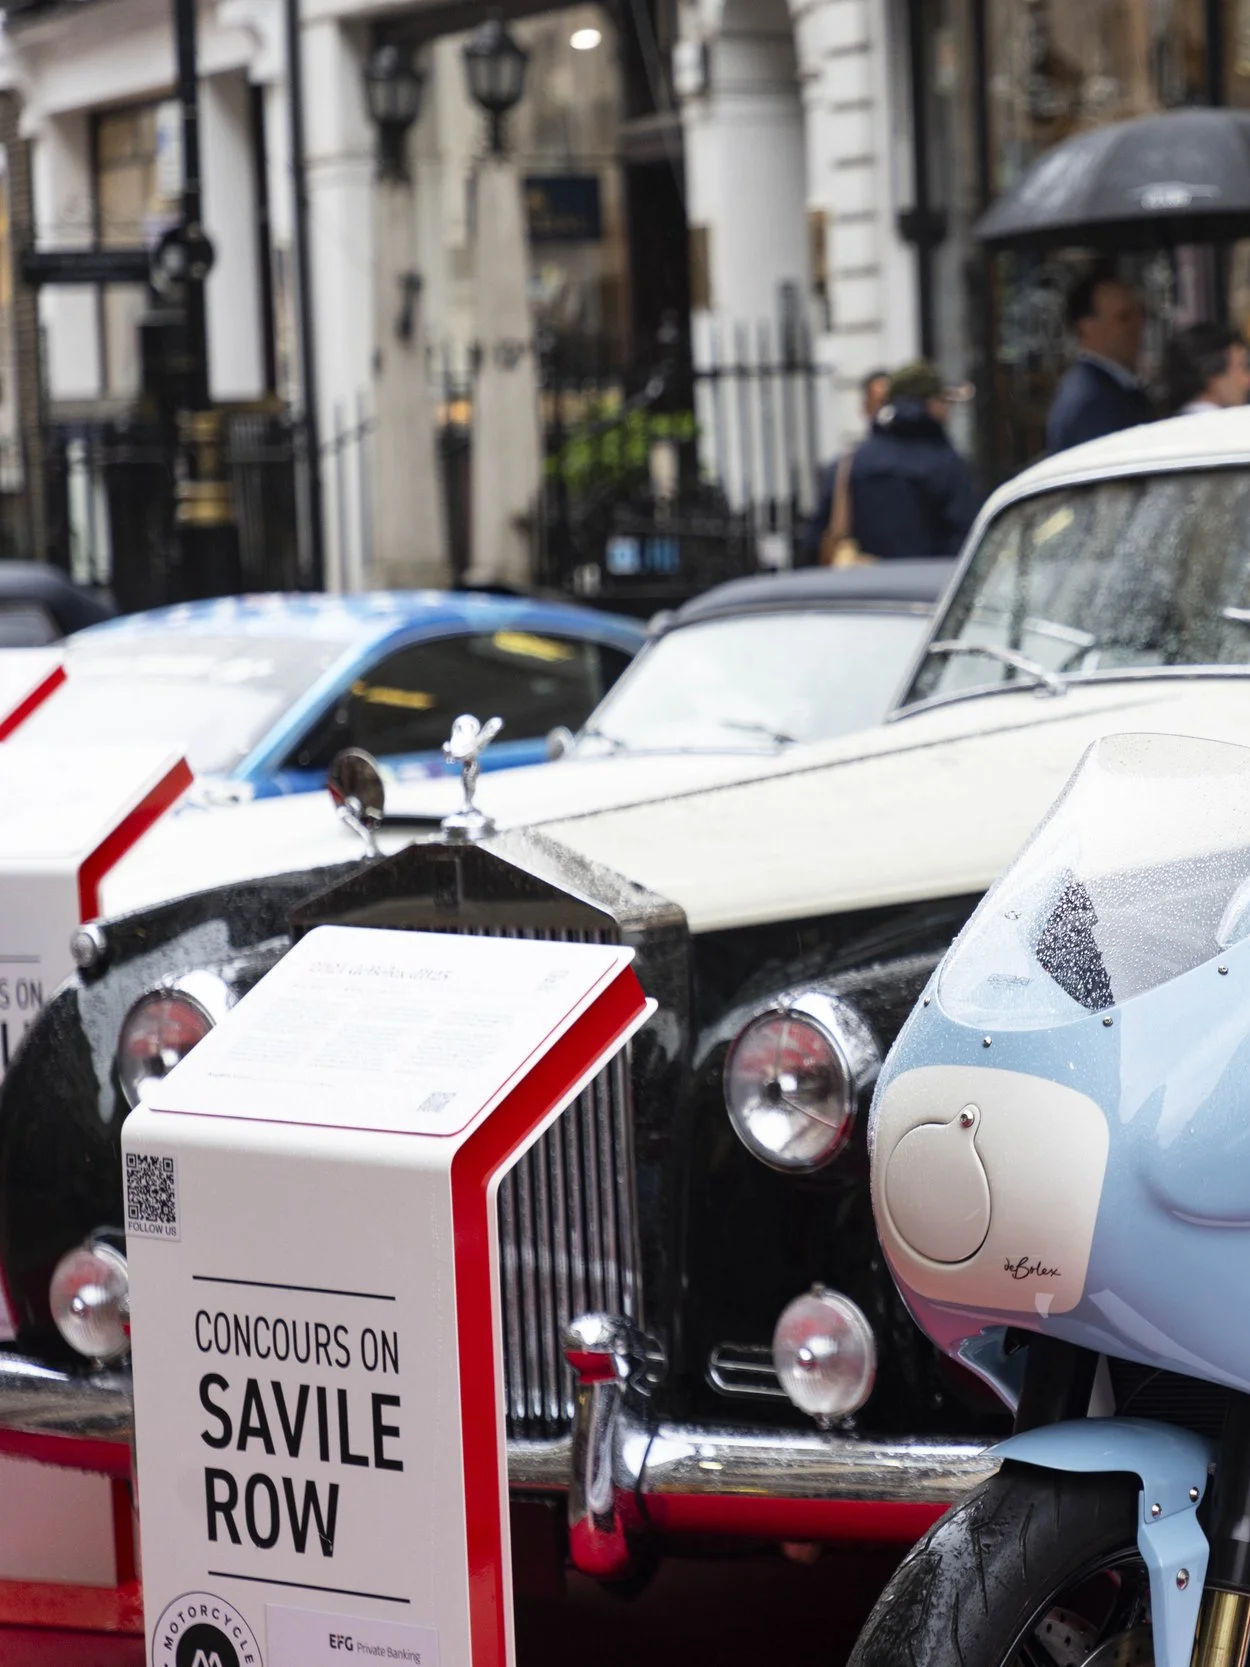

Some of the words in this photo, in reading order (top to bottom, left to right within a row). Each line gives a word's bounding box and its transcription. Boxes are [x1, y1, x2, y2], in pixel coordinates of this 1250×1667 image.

[128, 1220, 163, 1235] FOLLOW
[165, 1225, 177, 1237] US
[195, 1309, 351, 1368] CONCOURS
[360, 1327, 399, 1375] ON
[199, 1372, 404, 1472] SAVILE
[204, 1466, 340, 1558] ROW
[163, 1604, 255, 1665] MOTORCYCLE
[329, 1633, 354, 1652] EFG
[356, 1641, 386, 1658] Private
[387, 1646, 421, 1665] Banking
